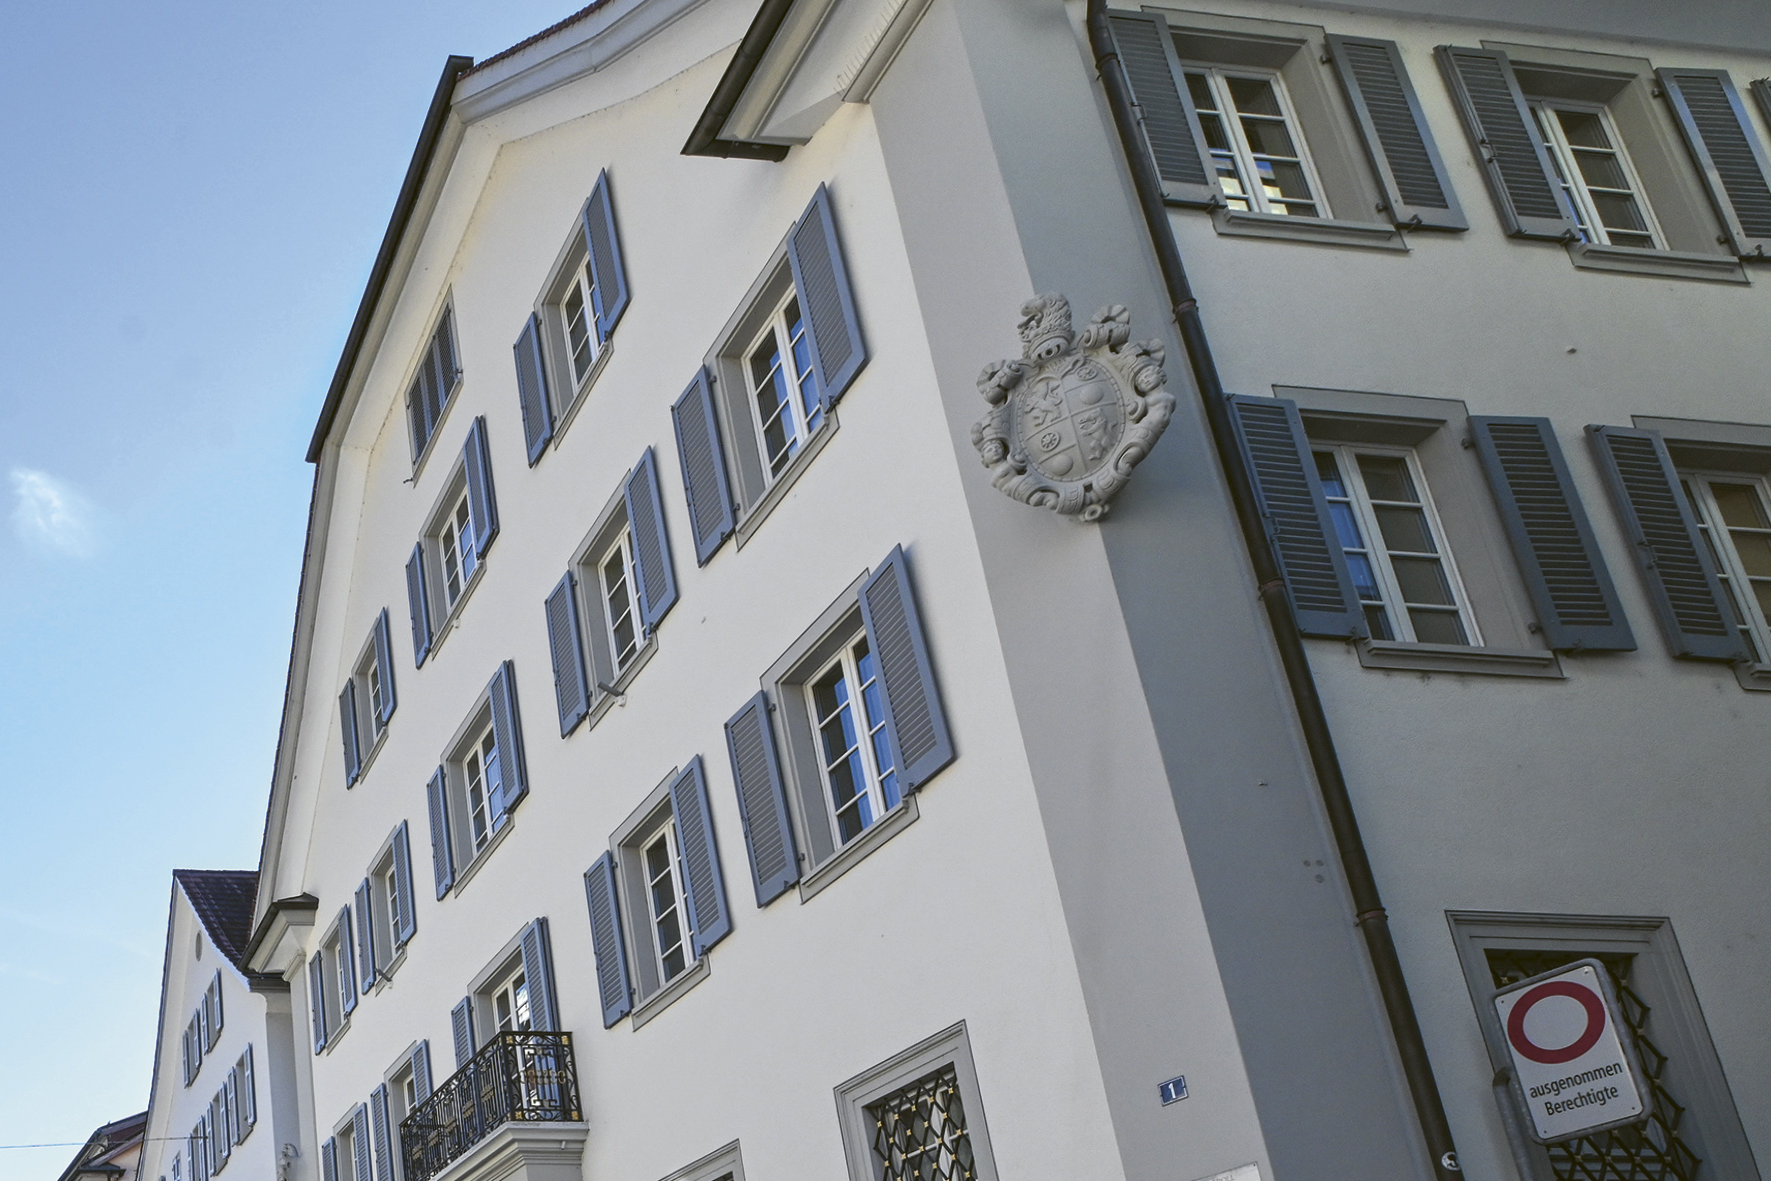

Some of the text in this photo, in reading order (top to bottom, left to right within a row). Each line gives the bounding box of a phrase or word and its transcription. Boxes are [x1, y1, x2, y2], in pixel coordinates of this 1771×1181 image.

[1168, 1082, 1176, 1099] 1
[1529, 1062, 1623, 1099] ausgenommen
[1544, 1085, 1619, 1116] Berechtigte
